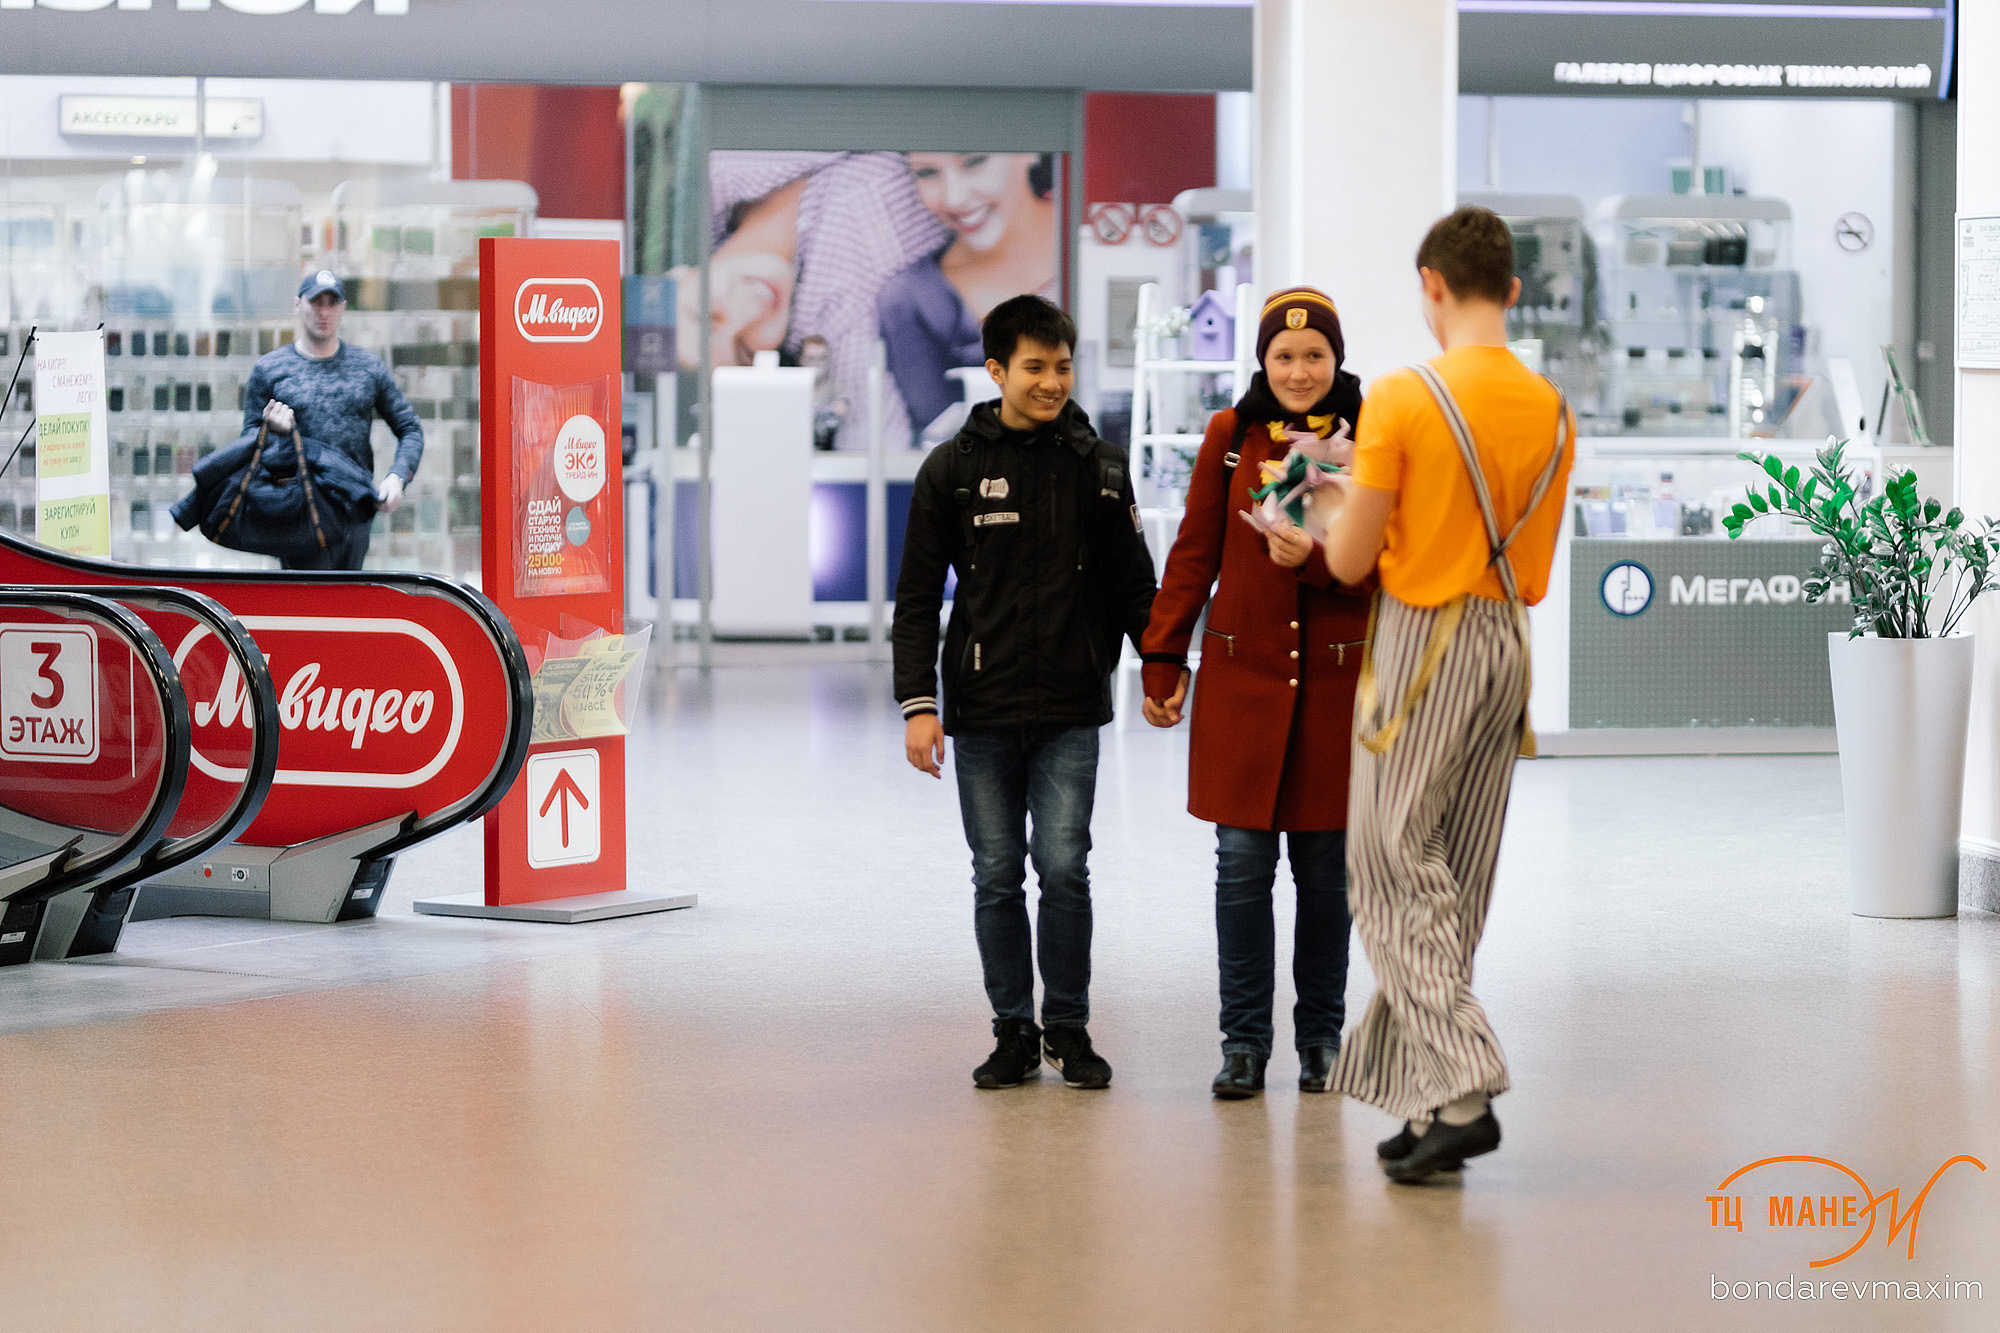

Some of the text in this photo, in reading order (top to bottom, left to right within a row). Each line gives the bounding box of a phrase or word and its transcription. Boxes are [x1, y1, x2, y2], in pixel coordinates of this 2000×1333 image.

[1785, 63, 1932, 88] ТЕХНОЛОГИЙ
[72, 111, 179, 126] АКСЕССУАРЫ
[522, 294, 597, 331] М.видео
[528, 495, 562, 516] СДАЙ
[528, 515, 561, 526] СТАРУЮ
[60, 525, 79, 540] КУПОН
[528, 525, 561, 535] ТЕХНИКУ
[528, 533, 562, 543] И ПОЛУЧИ
[528, 541, 562, 553] СКИДКУ
[528, 566, 562, 577] НА НОВУЮ
[31, 642, 64, 709] 3
[9, 715, 85, 745] ЭТАЖ
